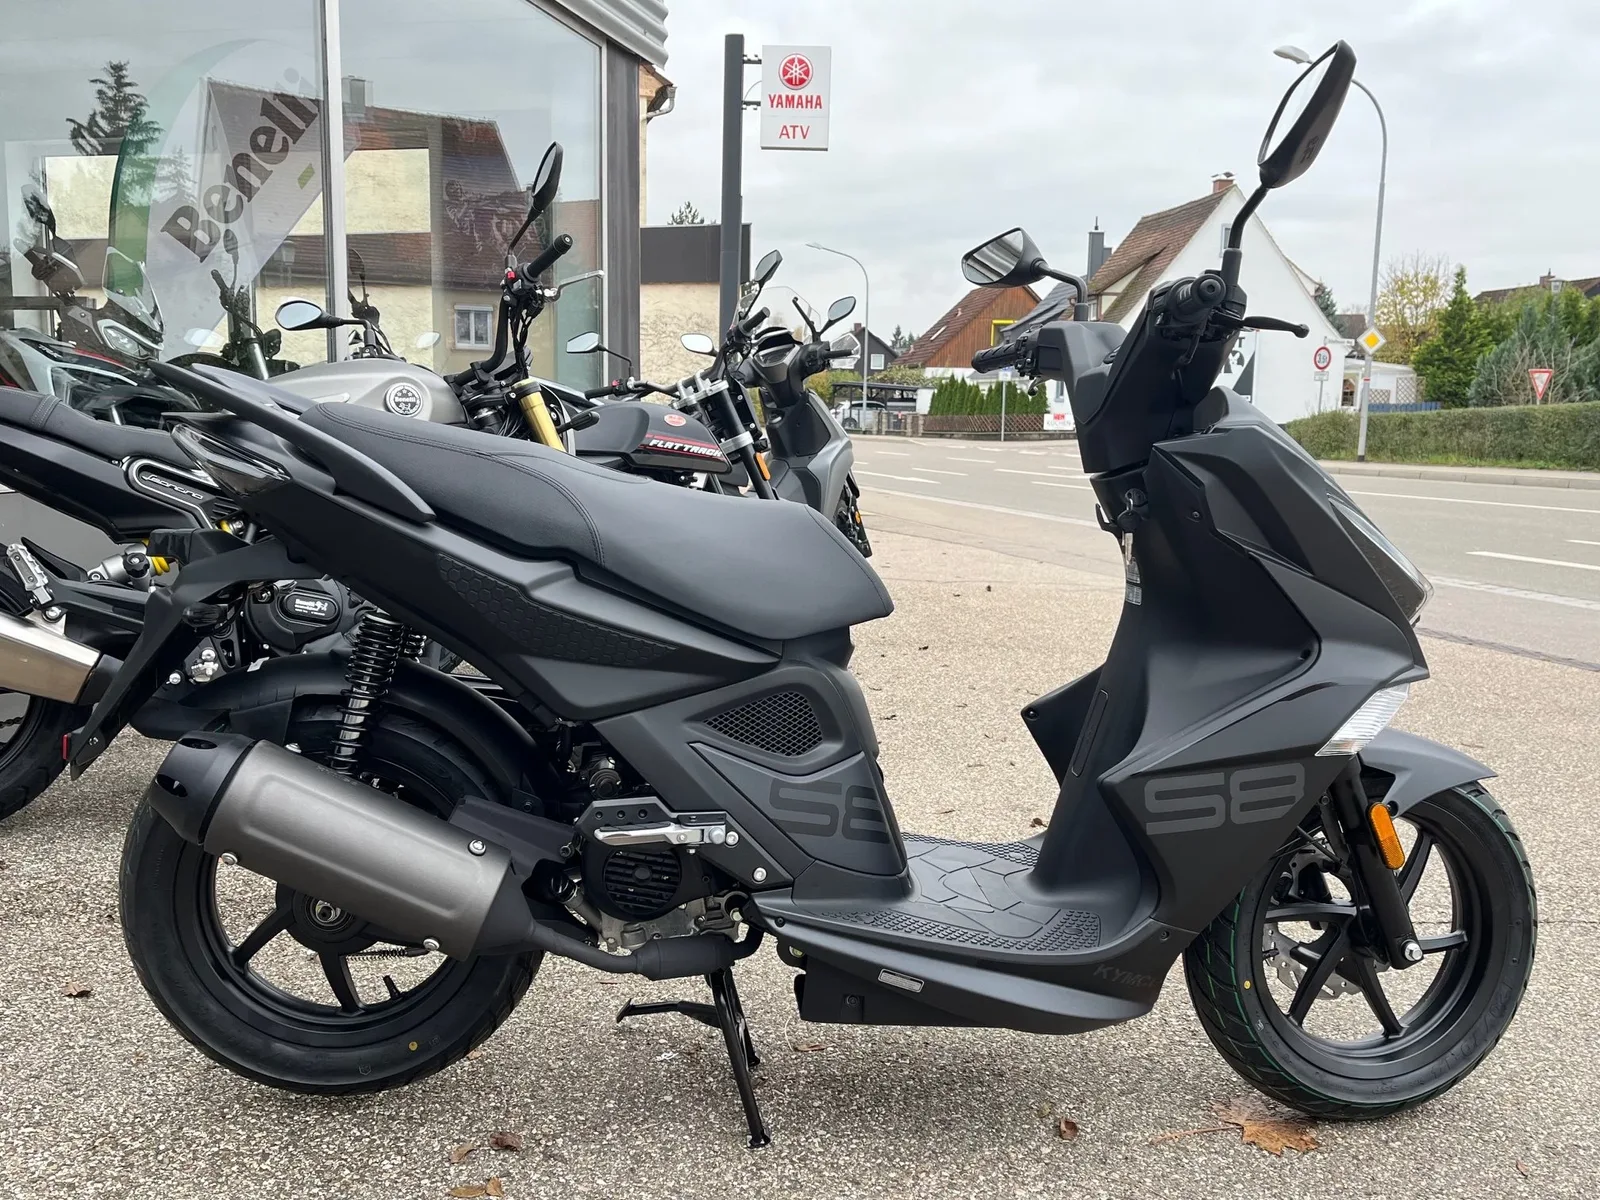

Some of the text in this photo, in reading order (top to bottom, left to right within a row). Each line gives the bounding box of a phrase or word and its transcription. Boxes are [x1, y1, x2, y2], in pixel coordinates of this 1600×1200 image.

[768, 94, 822, 109] YAMAHA
[779, 125, 810, 139] ATV
[160, 67, 321, 263] Benelli
[1144, 763, 1305, 835] S8
